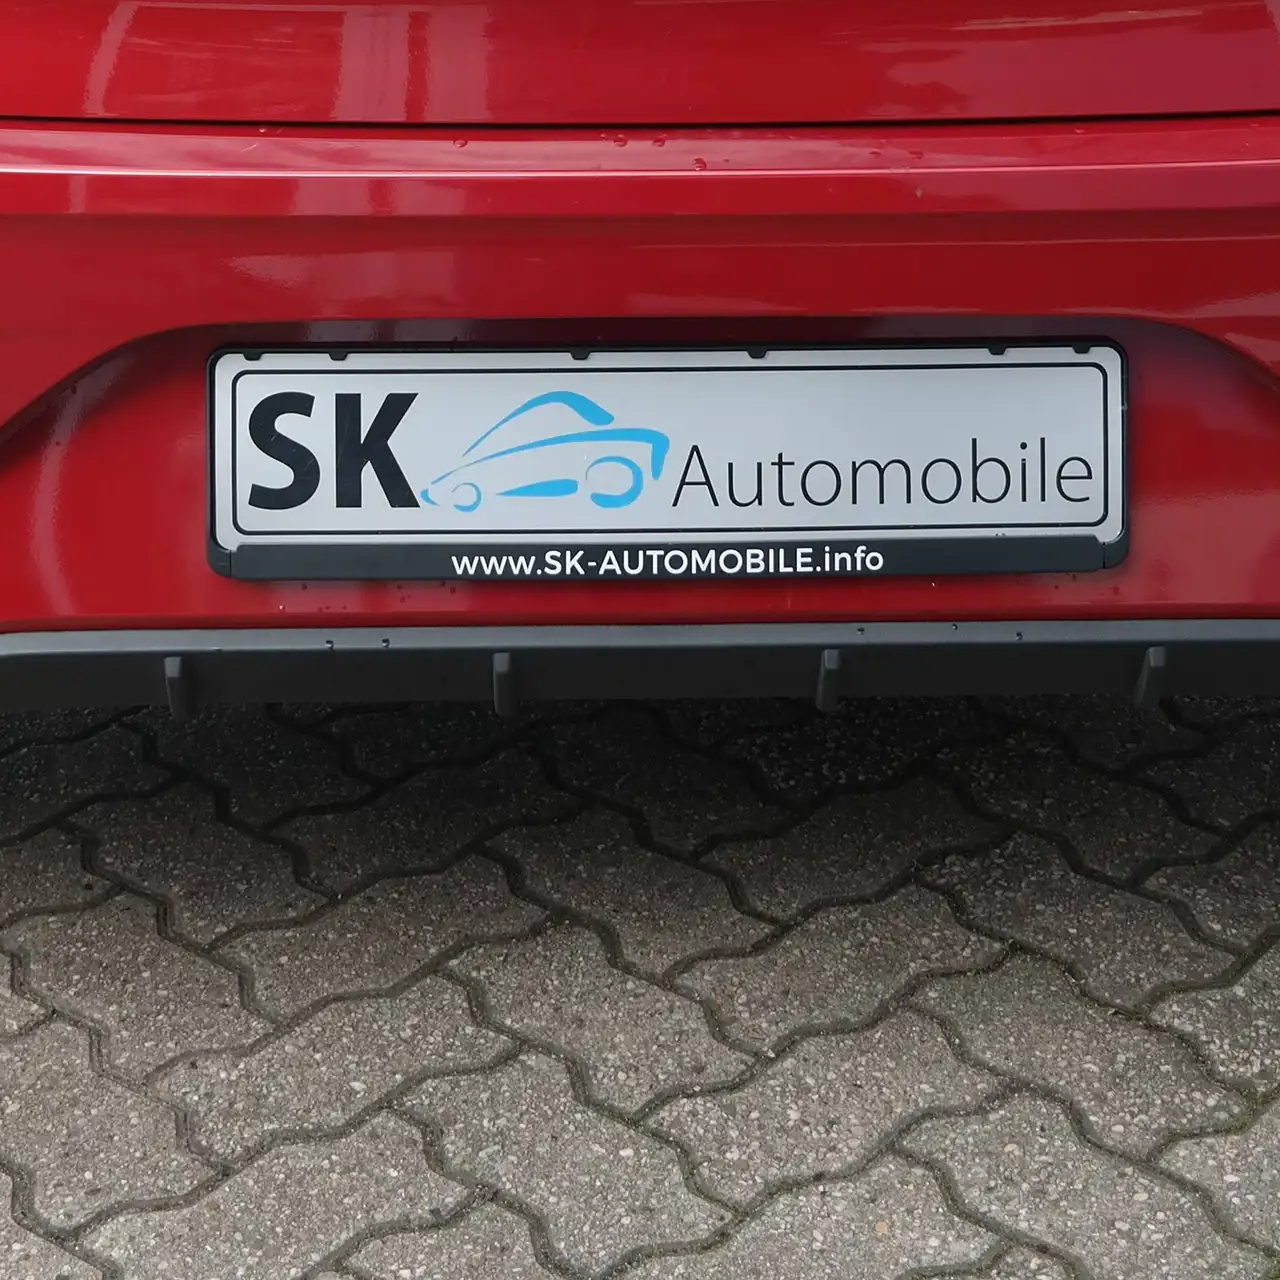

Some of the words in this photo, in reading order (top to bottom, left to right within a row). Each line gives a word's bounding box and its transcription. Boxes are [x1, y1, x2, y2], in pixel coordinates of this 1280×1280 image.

[248, 391, 420, 510] SK
[671, 437, 1093, 508] Automobile
[451, 546, 884, 575] www.SK-AUTOMOBILE.info
